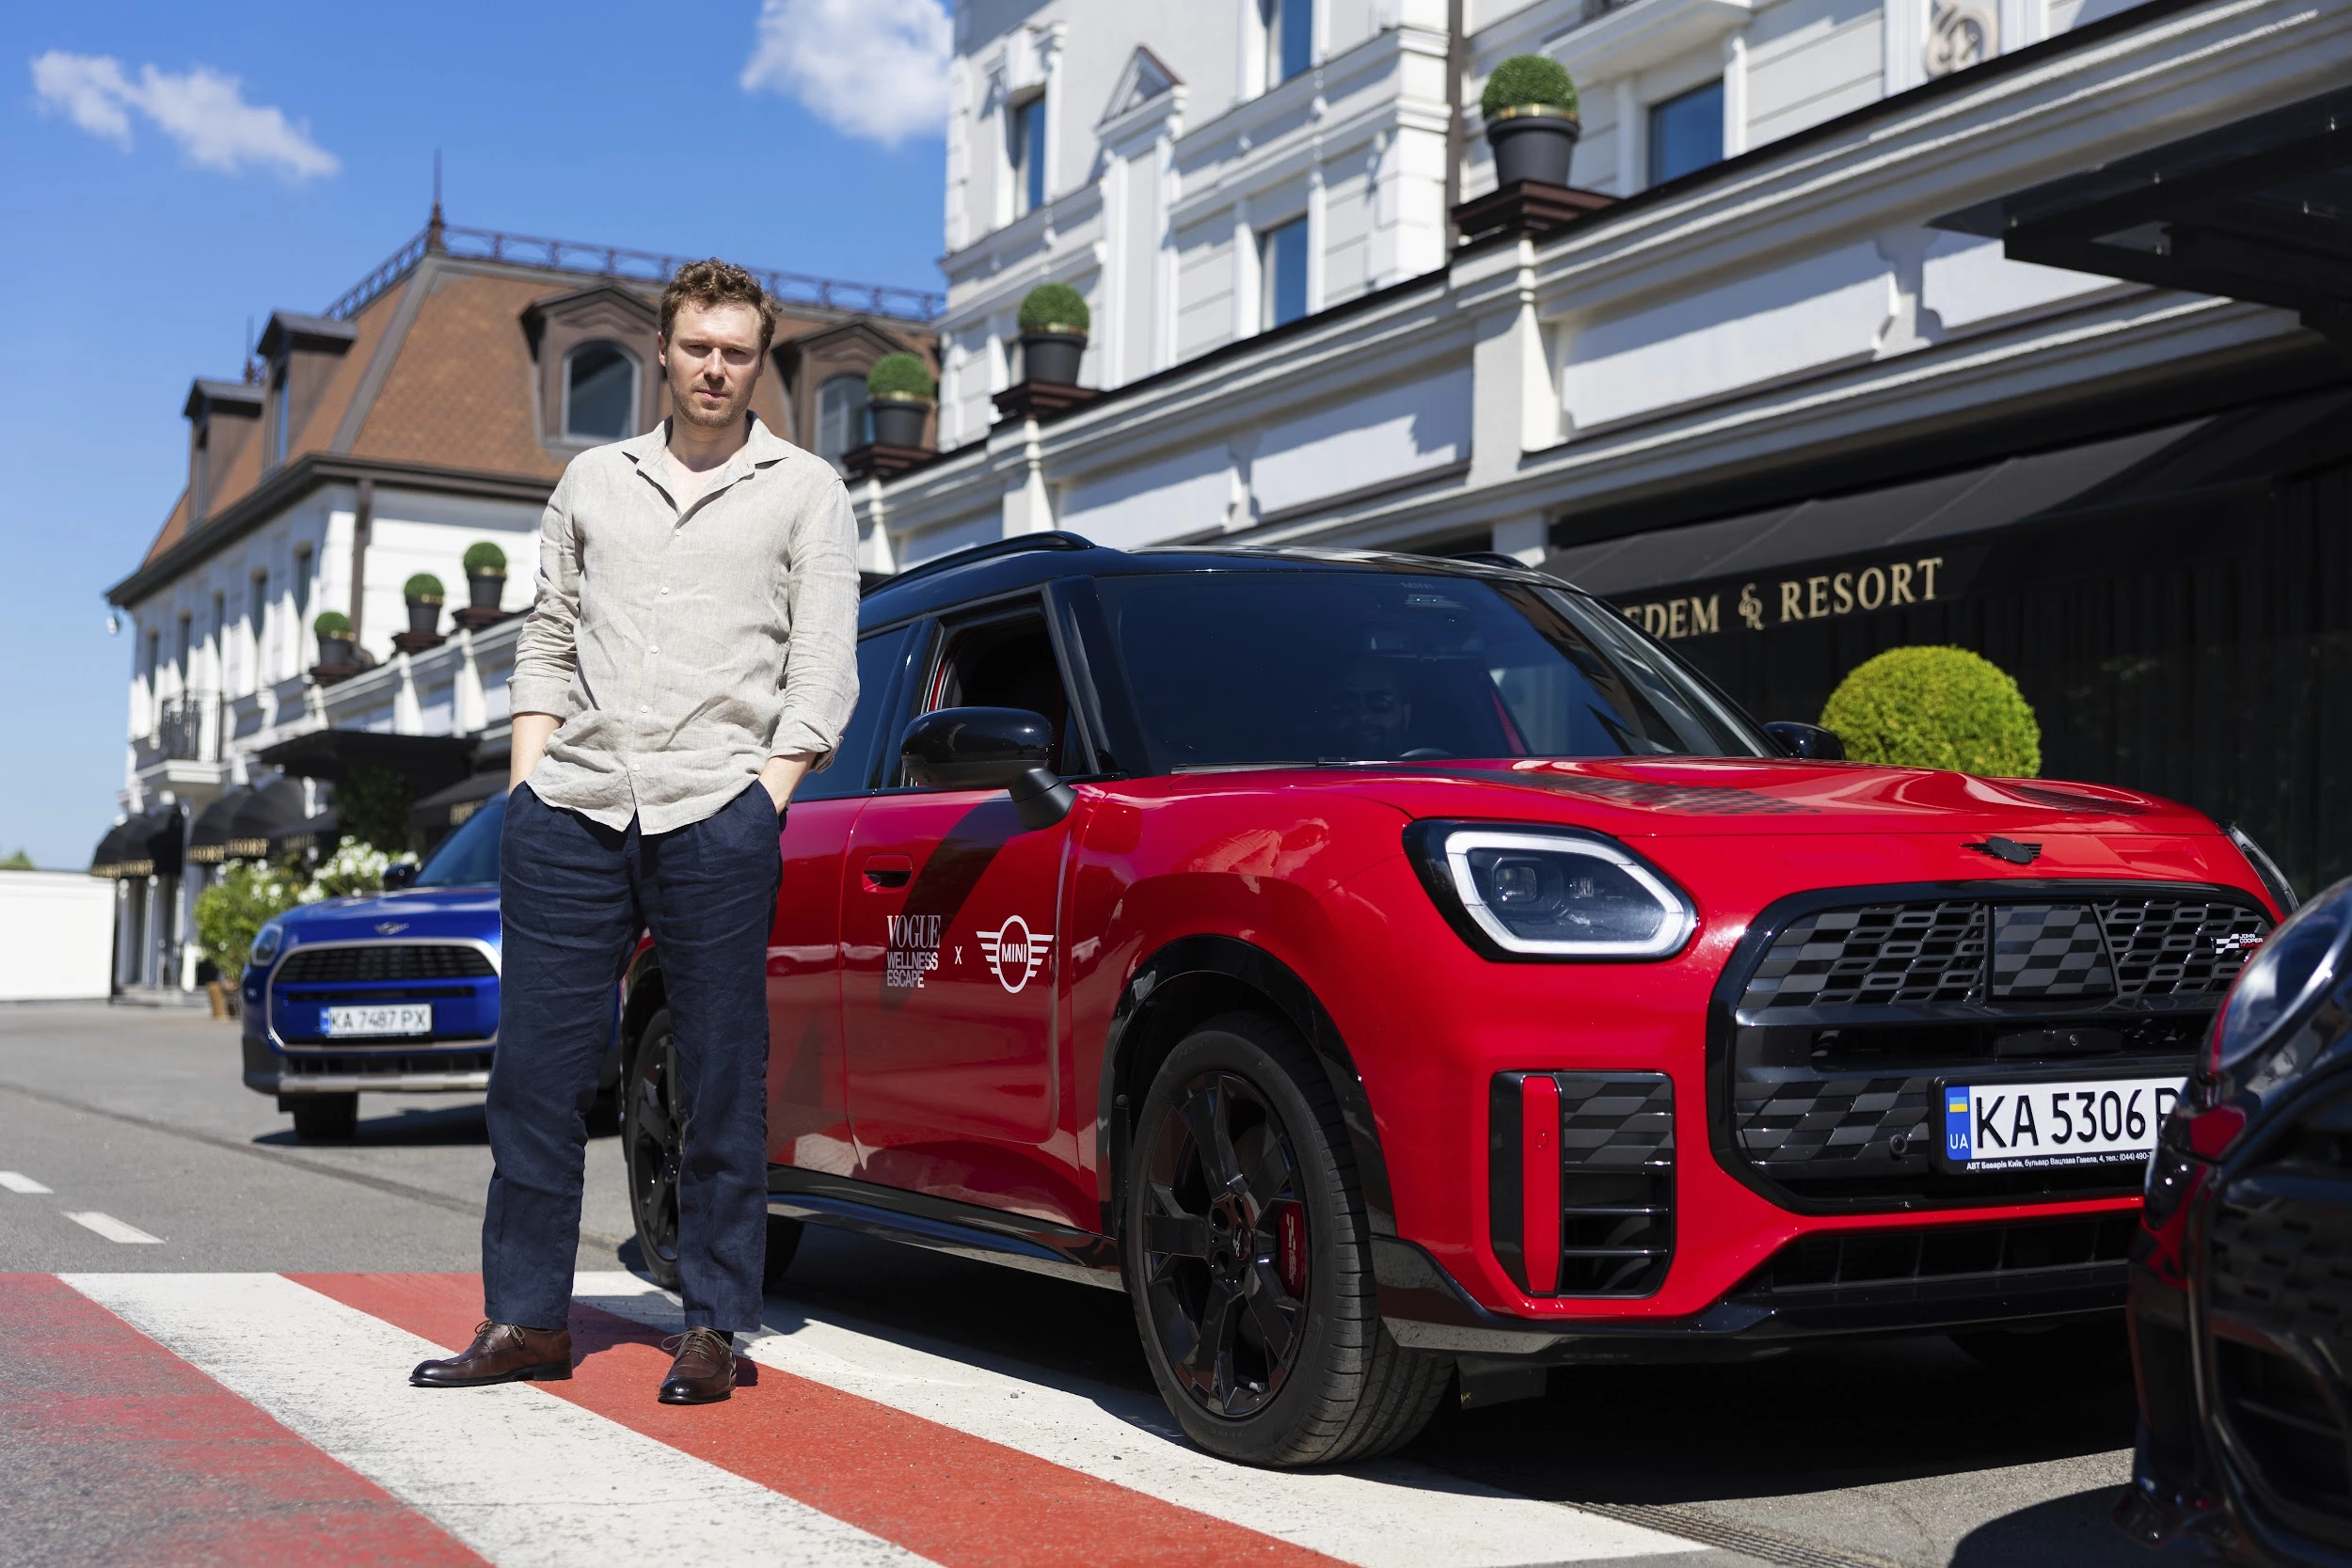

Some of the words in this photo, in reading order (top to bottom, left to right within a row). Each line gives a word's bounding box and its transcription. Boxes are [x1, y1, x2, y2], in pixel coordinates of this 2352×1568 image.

[1779, 557, 1944, 623] RESORT
[886, 914, 941, 948] VOGUE
[886, 951, 939, 971] WELLNESS
[1001, 943, 1027, 963] MINI
[886, 969, 925, 988] ESCAPE
[330, 1010, 354, 1029] KA
[358, 1009, 396, 1028] 7487
[401, 1008, 426, 1027] PX
[1976, 1094, 2040, 1149] KA
[2051, 1087, 2147, 1145] 5306
[1949, 1132, 1969, 1150] UA
[1966, 1162, 1980, 1170] АВТ
[1981, 1160, 2007, 1170] Баварія
[2025, 1159, 2049, 1167] бульвар
[2050, 1157, 2075, 1166] Вацлава
[2119, 1152, 2135, 1161] (044)
